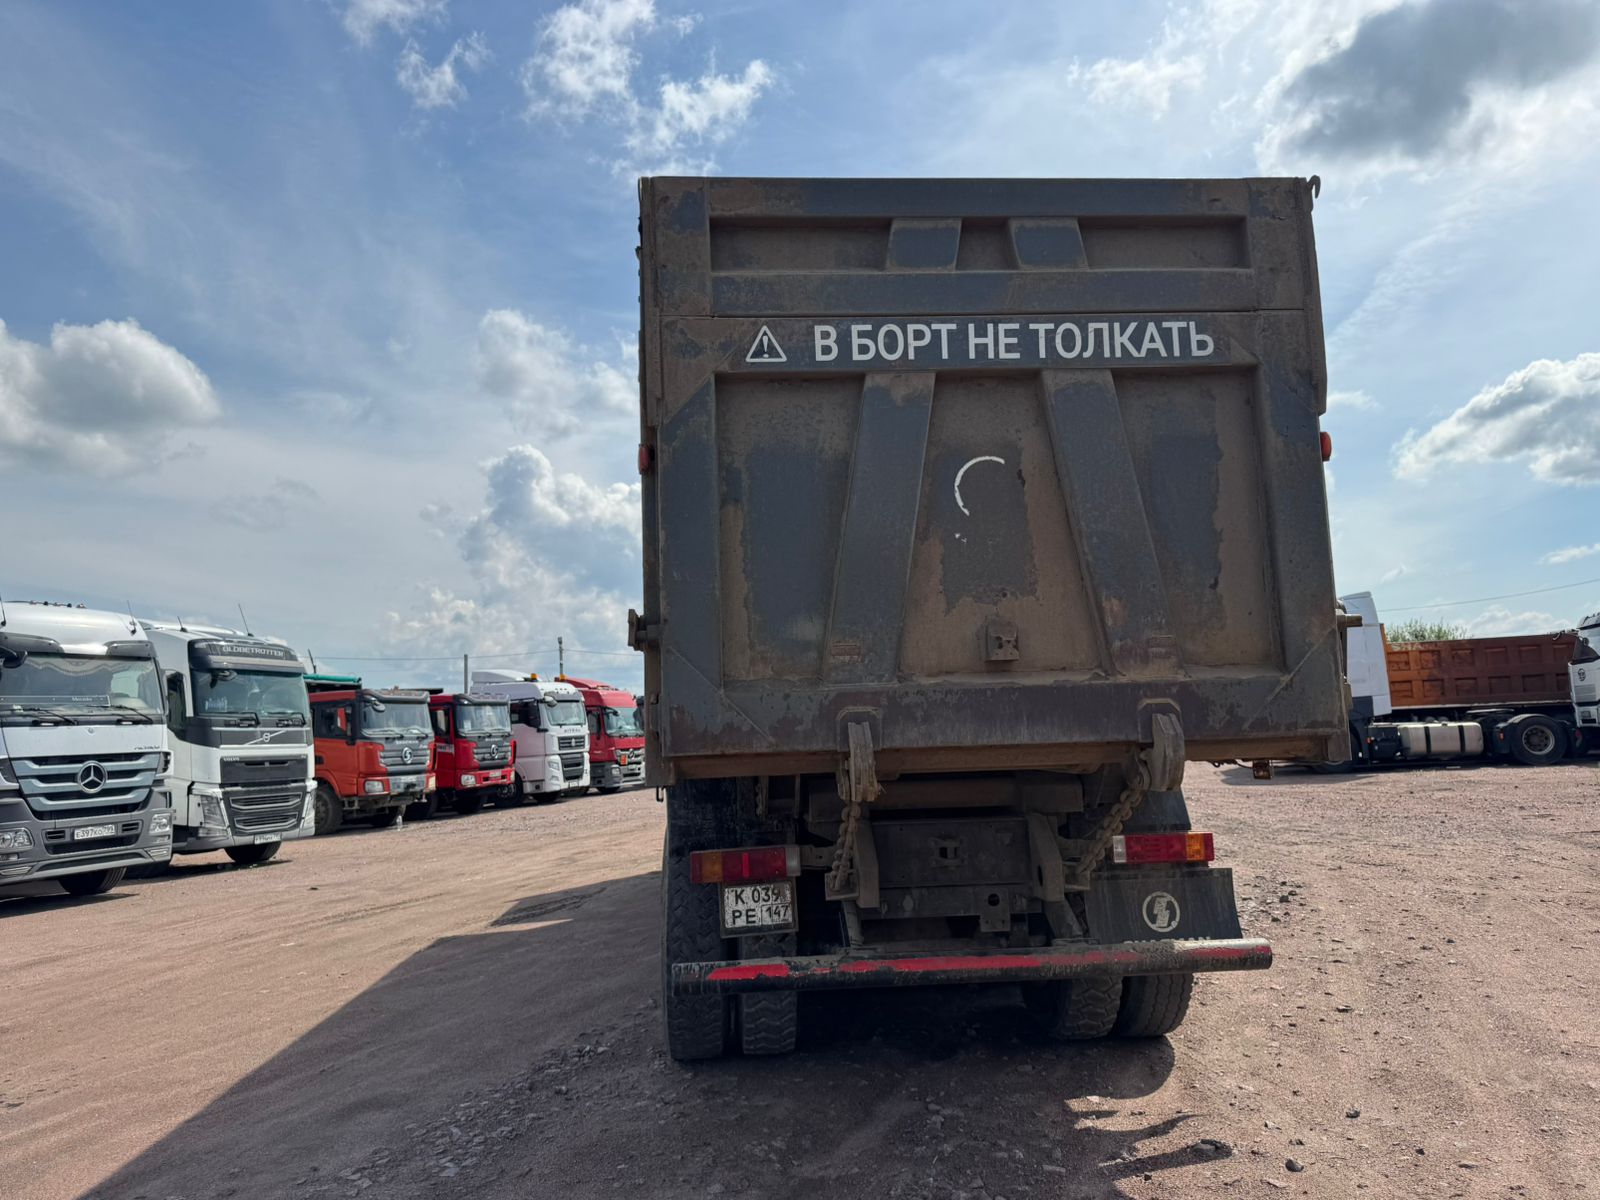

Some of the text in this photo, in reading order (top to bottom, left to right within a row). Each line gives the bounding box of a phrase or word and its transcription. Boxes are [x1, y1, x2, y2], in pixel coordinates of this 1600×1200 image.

[813, 320, 1215, 362] В БОРТ НЕ ТОЛКАТЬ
[732, 905, 789, 925] РЕ 147
